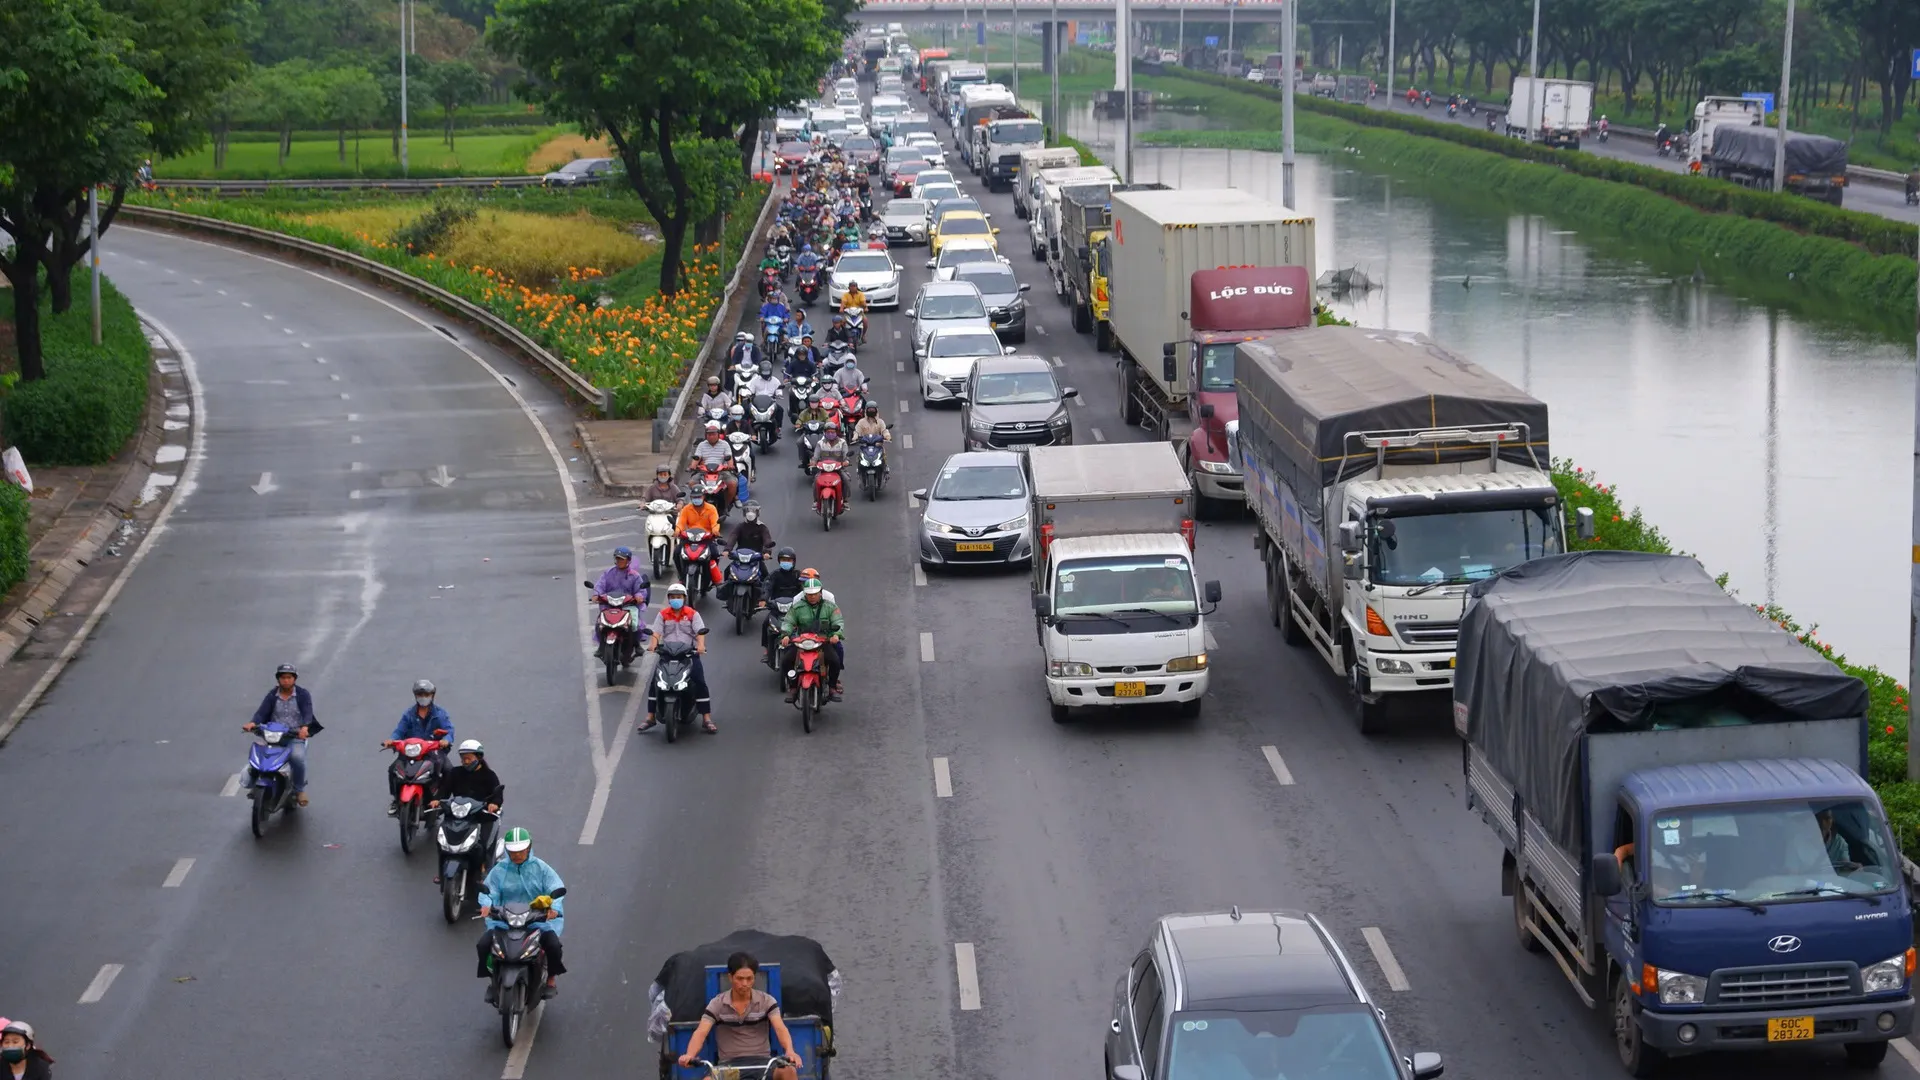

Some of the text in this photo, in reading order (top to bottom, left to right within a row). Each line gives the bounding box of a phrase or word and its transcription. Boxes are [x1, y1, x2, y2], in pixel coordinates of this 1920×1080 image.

[1210, 282, 1294, 301] LỘC ĐỨC
[1779, 1018, 1801, 1029] 60C
[1772, 1027, 1810, 1040] 283.22
